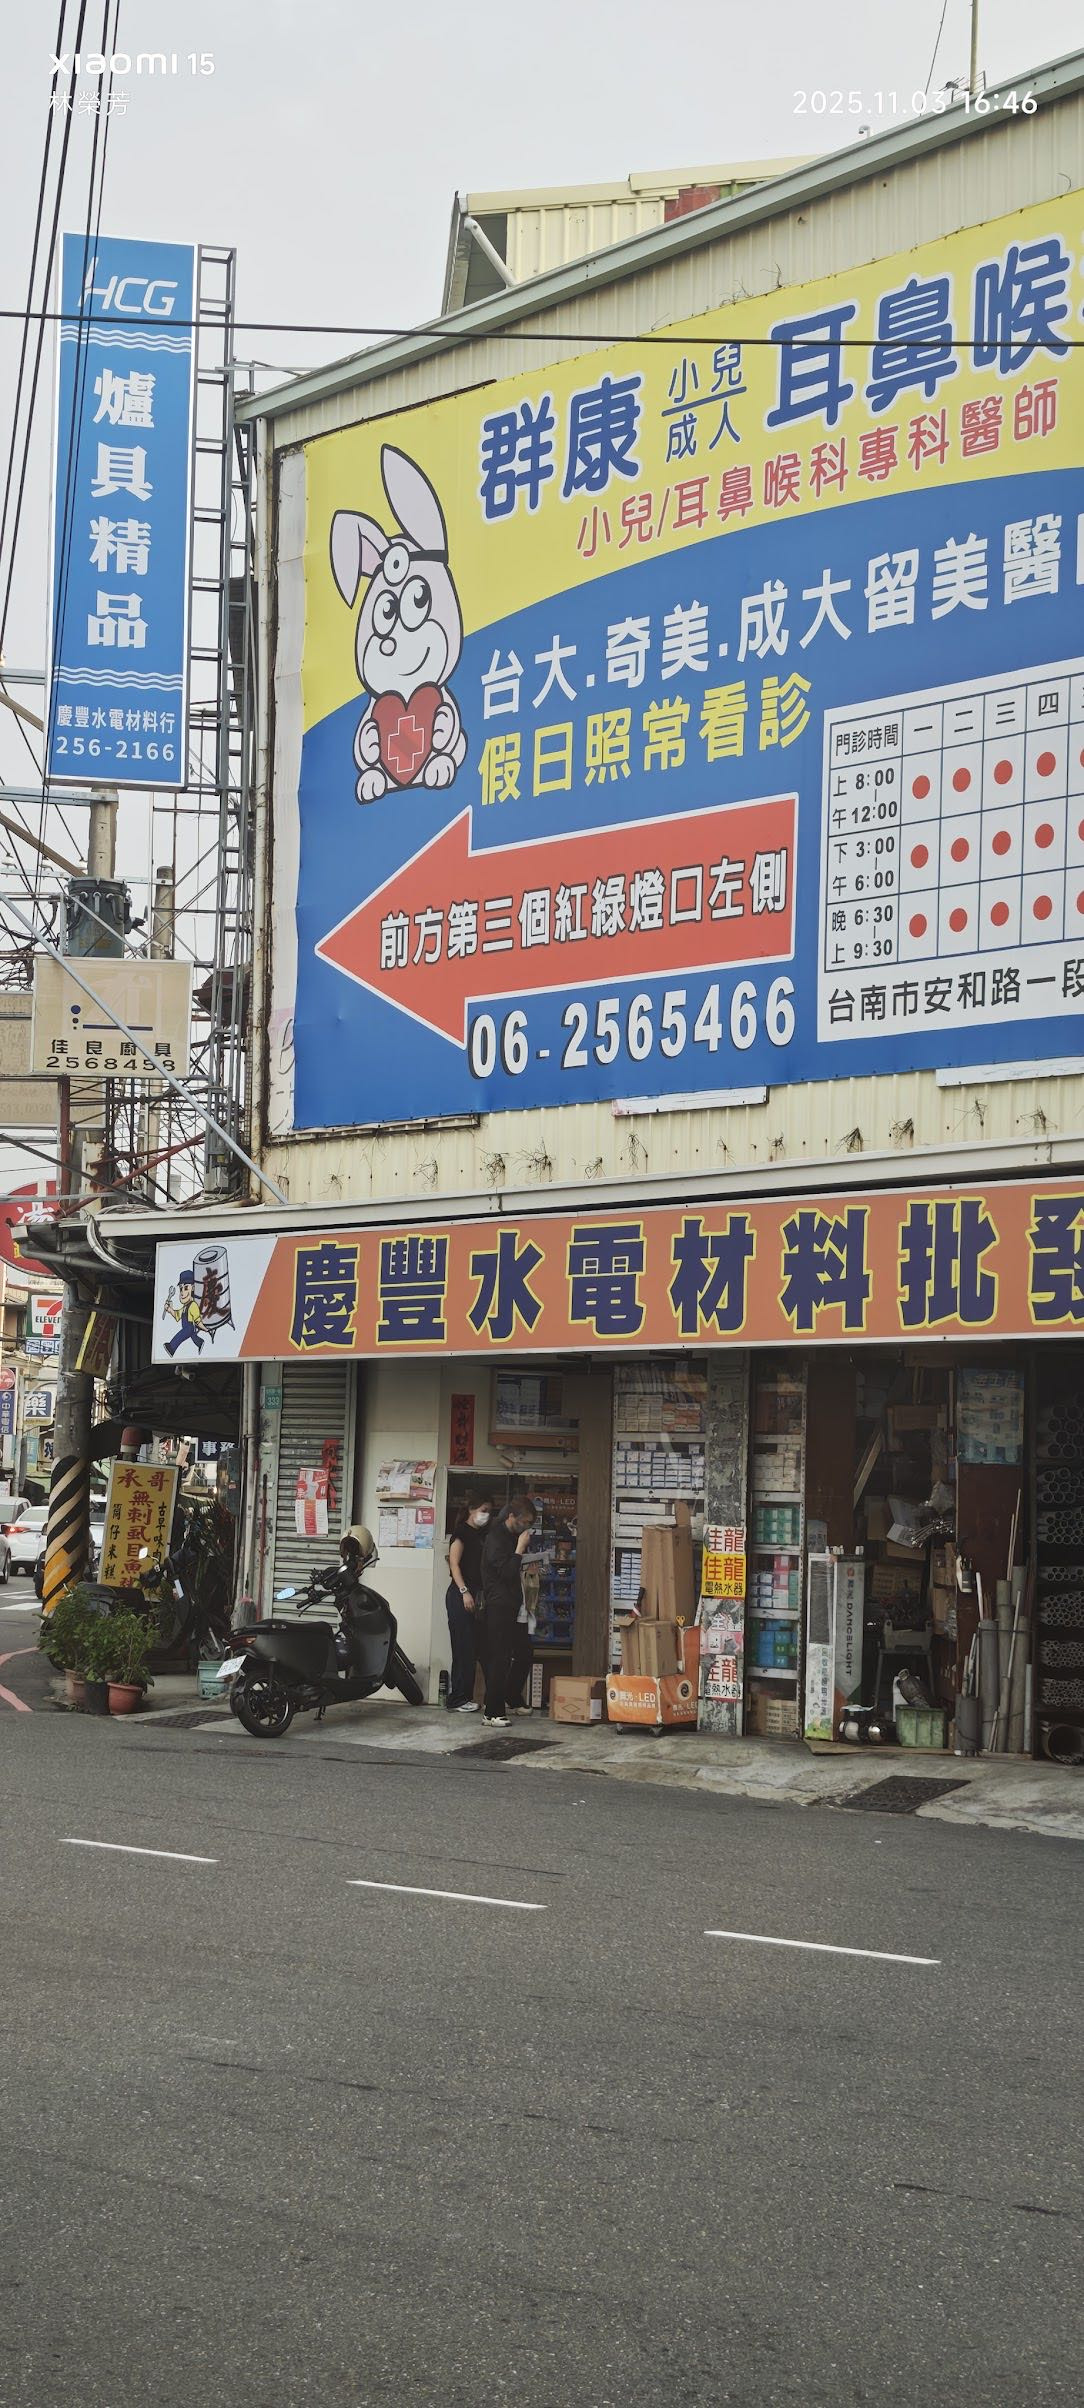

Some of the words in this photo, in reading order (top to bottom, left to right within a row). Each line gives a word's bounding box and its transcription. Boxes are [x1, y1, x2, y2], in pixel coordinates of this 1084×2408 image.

[77, 257, 178, 316] HCG
[766, 238, 1084, 429] 耳鼻喉
[667, 343, 743, 404] 小兒
[666, 401, 741, 463] 成人
[480, 375, 642, 520] 群康
[577, 378, 1058, 558] 小兒/耳鼻喉科專科醫師
[87, 369, 156, 649] 爐具精品
[480, 511, 1084, 719] 台大.奇美.成大留美醫
[995, 701, 1016, 725] 三
[1038, 692, 1060, 717] 四
[56, 704, 175, 735] 慶豐水電材料行
[954, 710, 973, 733] 二
[56, 735, 175, 762] 256-2166
[478, 672, 811, 805] 假日照常看診
[835, 723, 899, 757] 門診時間
[855, 767, 895, 788] 8:00
[851, 800, 898, 825] 12:00
[856, 835, 895, 856] 3:00
[855, 869, 894, 891] 6:00
[380, 849, 788, 969] 前方第三個紅綠燈口左側
[854, 905, 893, 926] 6:30
[853, 938, 892, 960] 9:30
[469, 976, 796, 1080] 06-2565466
[51, 1038, 172, 1057] 佳良廚具
[46, 1056, 176, 1073] 2568458
[25, 1392, 47, 1416] 藥
[117, 1468, 170, 1492] 承哥
[704, 1556, 744, 1581] 佳龍
[705, 1581, 743, 1595] 電熱水器
[845, 1603, 853, 1676] DANCELIGHT
